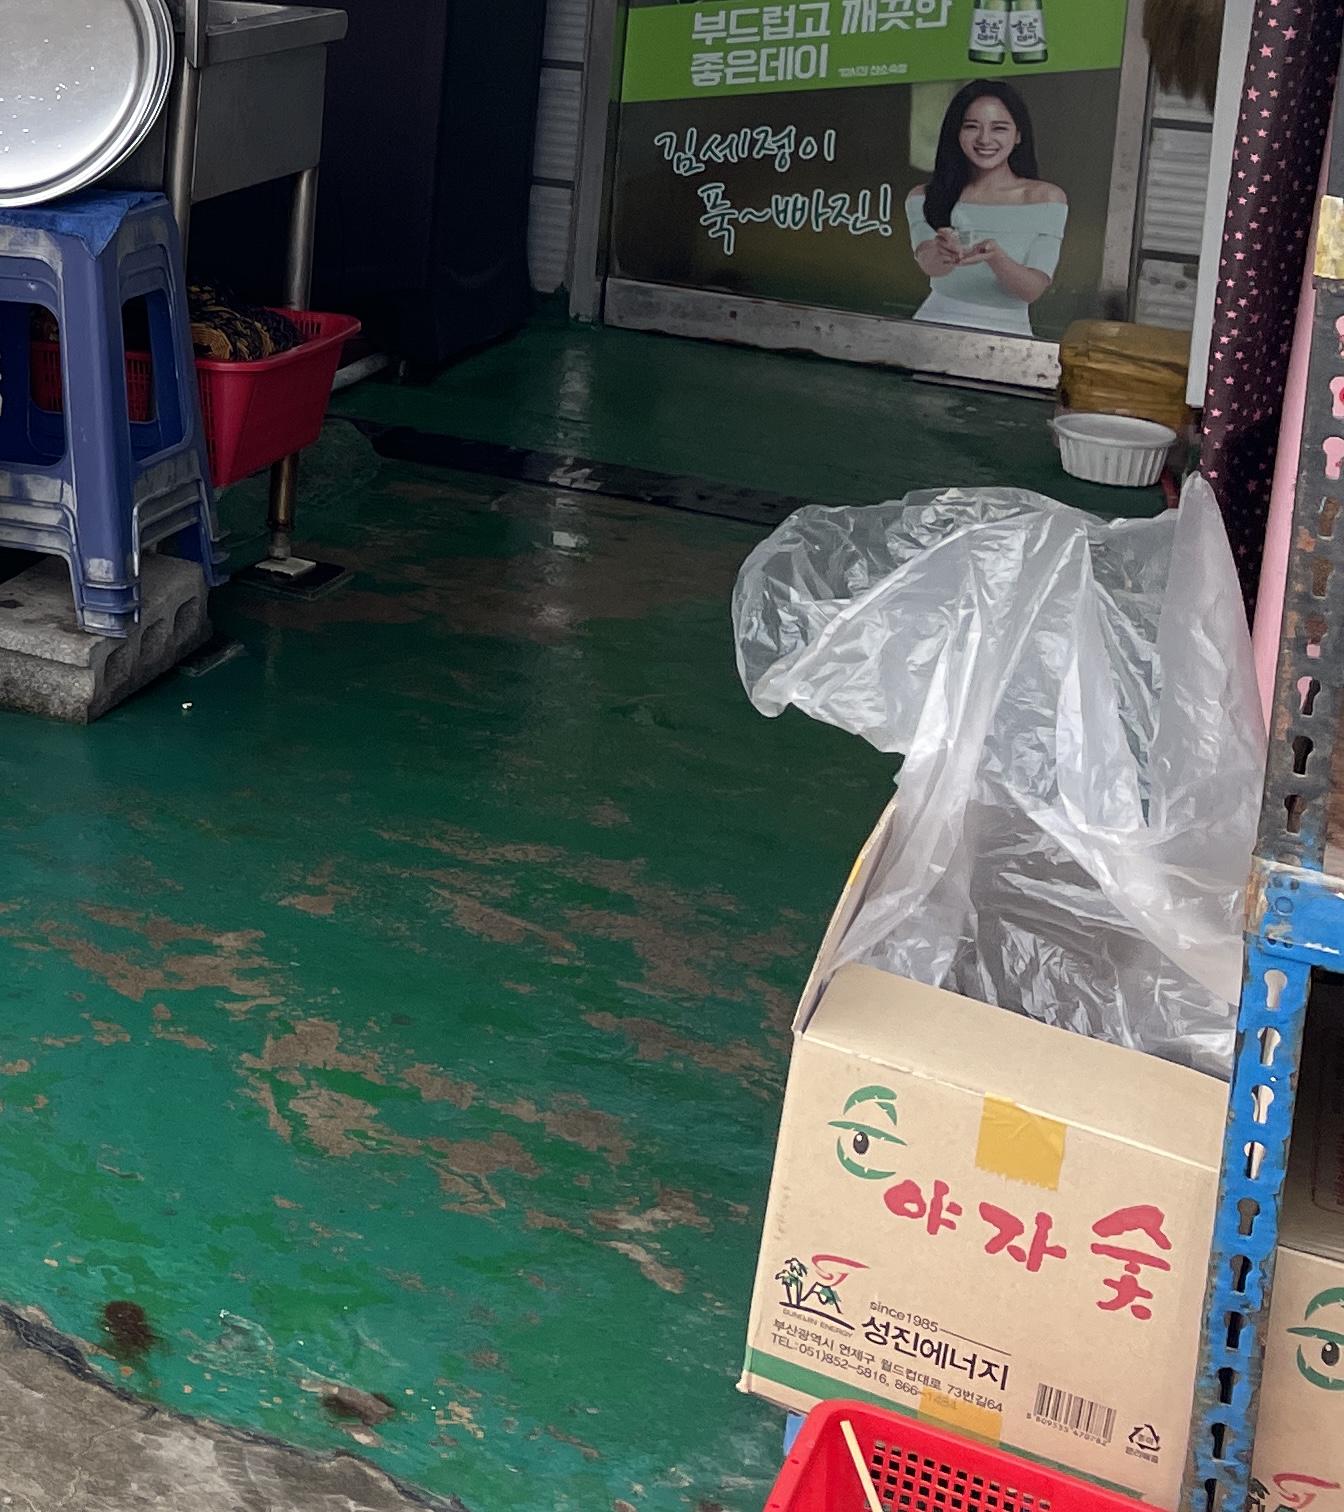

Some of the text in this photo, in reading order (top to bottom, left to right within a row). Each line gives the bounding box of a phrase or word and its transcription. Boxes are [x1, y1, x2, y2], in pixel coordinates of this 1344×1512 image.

[691, 1, 831, 46] 부드럽고
[691, 43, 829, 88] 좋은데이
[654, 125, 836, 176] 김세정이
[869, 1300, 938, 1333] since1985
[773, 1318, 834, 1351] 부산광역시
[839, 1343, 876, 1365] 연제구
[881, 1358, 943, 1390] 월드컵대로
[861, 1315, 1009, 1391] 성진에너지
